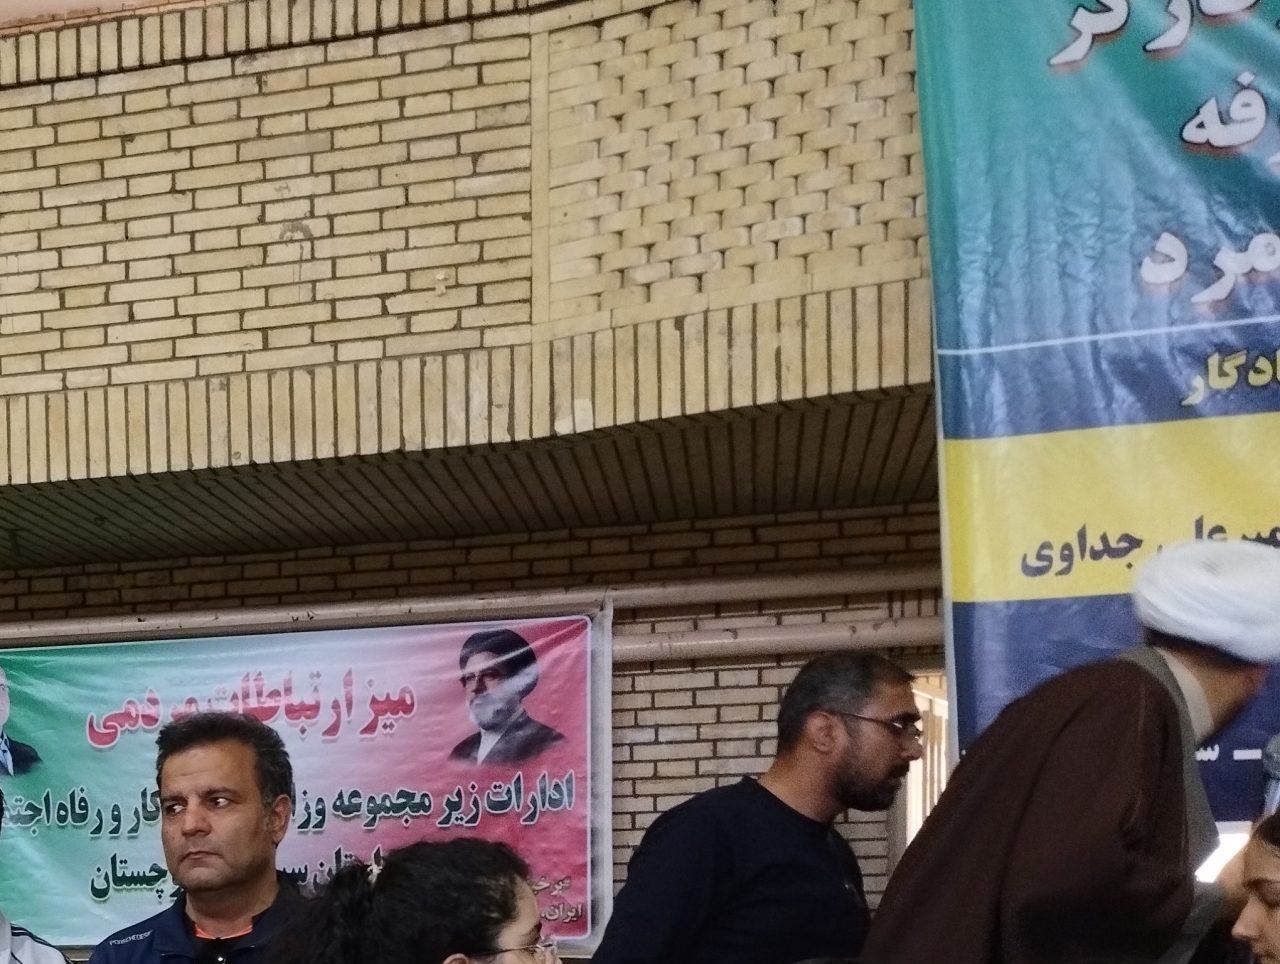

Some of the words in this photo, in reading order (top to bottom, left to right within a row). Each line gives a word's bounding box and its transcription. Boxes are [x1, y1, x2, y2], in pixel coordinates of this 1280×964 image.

[1021, 524, 1144, 578] جداوی
[359, 678, 416, 735] میز
[55, 786, 104, 836] رفاه
[108, 803, 122, 836] و
[127, 787, 161, 836] کار
[288, 782, 327, 831] وزا
[332, 785, 433, 829] مجموعه
[437, 782, 481, 826] زیر
[485, 771, 575, 825] ادارات
